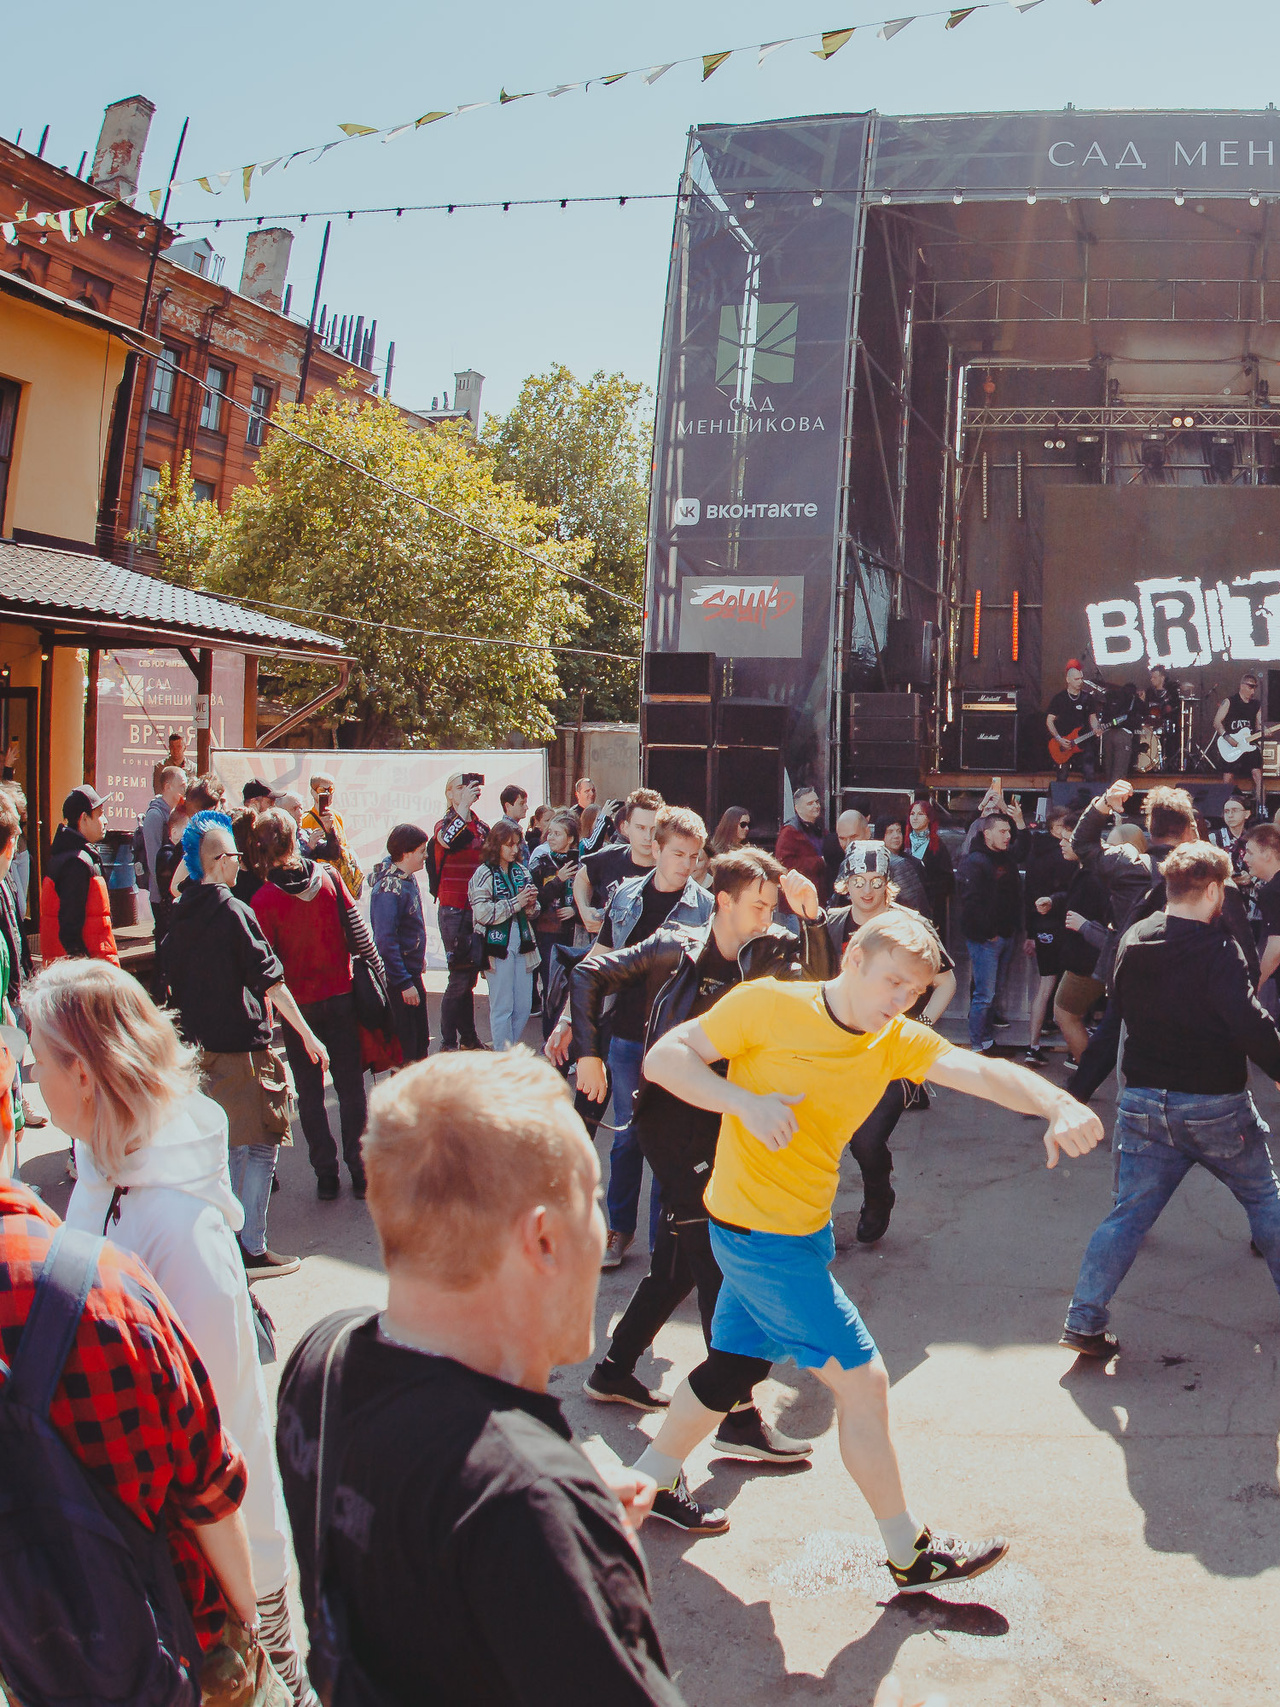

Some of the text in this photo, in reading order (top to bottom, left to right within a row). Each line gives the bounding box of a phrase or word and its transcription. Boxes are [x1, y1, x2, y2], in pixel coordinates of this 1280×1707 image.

[1048, 140, 1147, 169] САД
[729, 396, 775, 412] САД
[677, 416, 825, 435] МЕНШИКОВА
[148, 678, 171, 690] САД
[148, 693, 224, 706] МЕНШИВА
[195, 702, 206, 713] WC
[107, 775, 148, 788] ВРЕМЯ
[108, 806, 137, 819] БИТЬ
